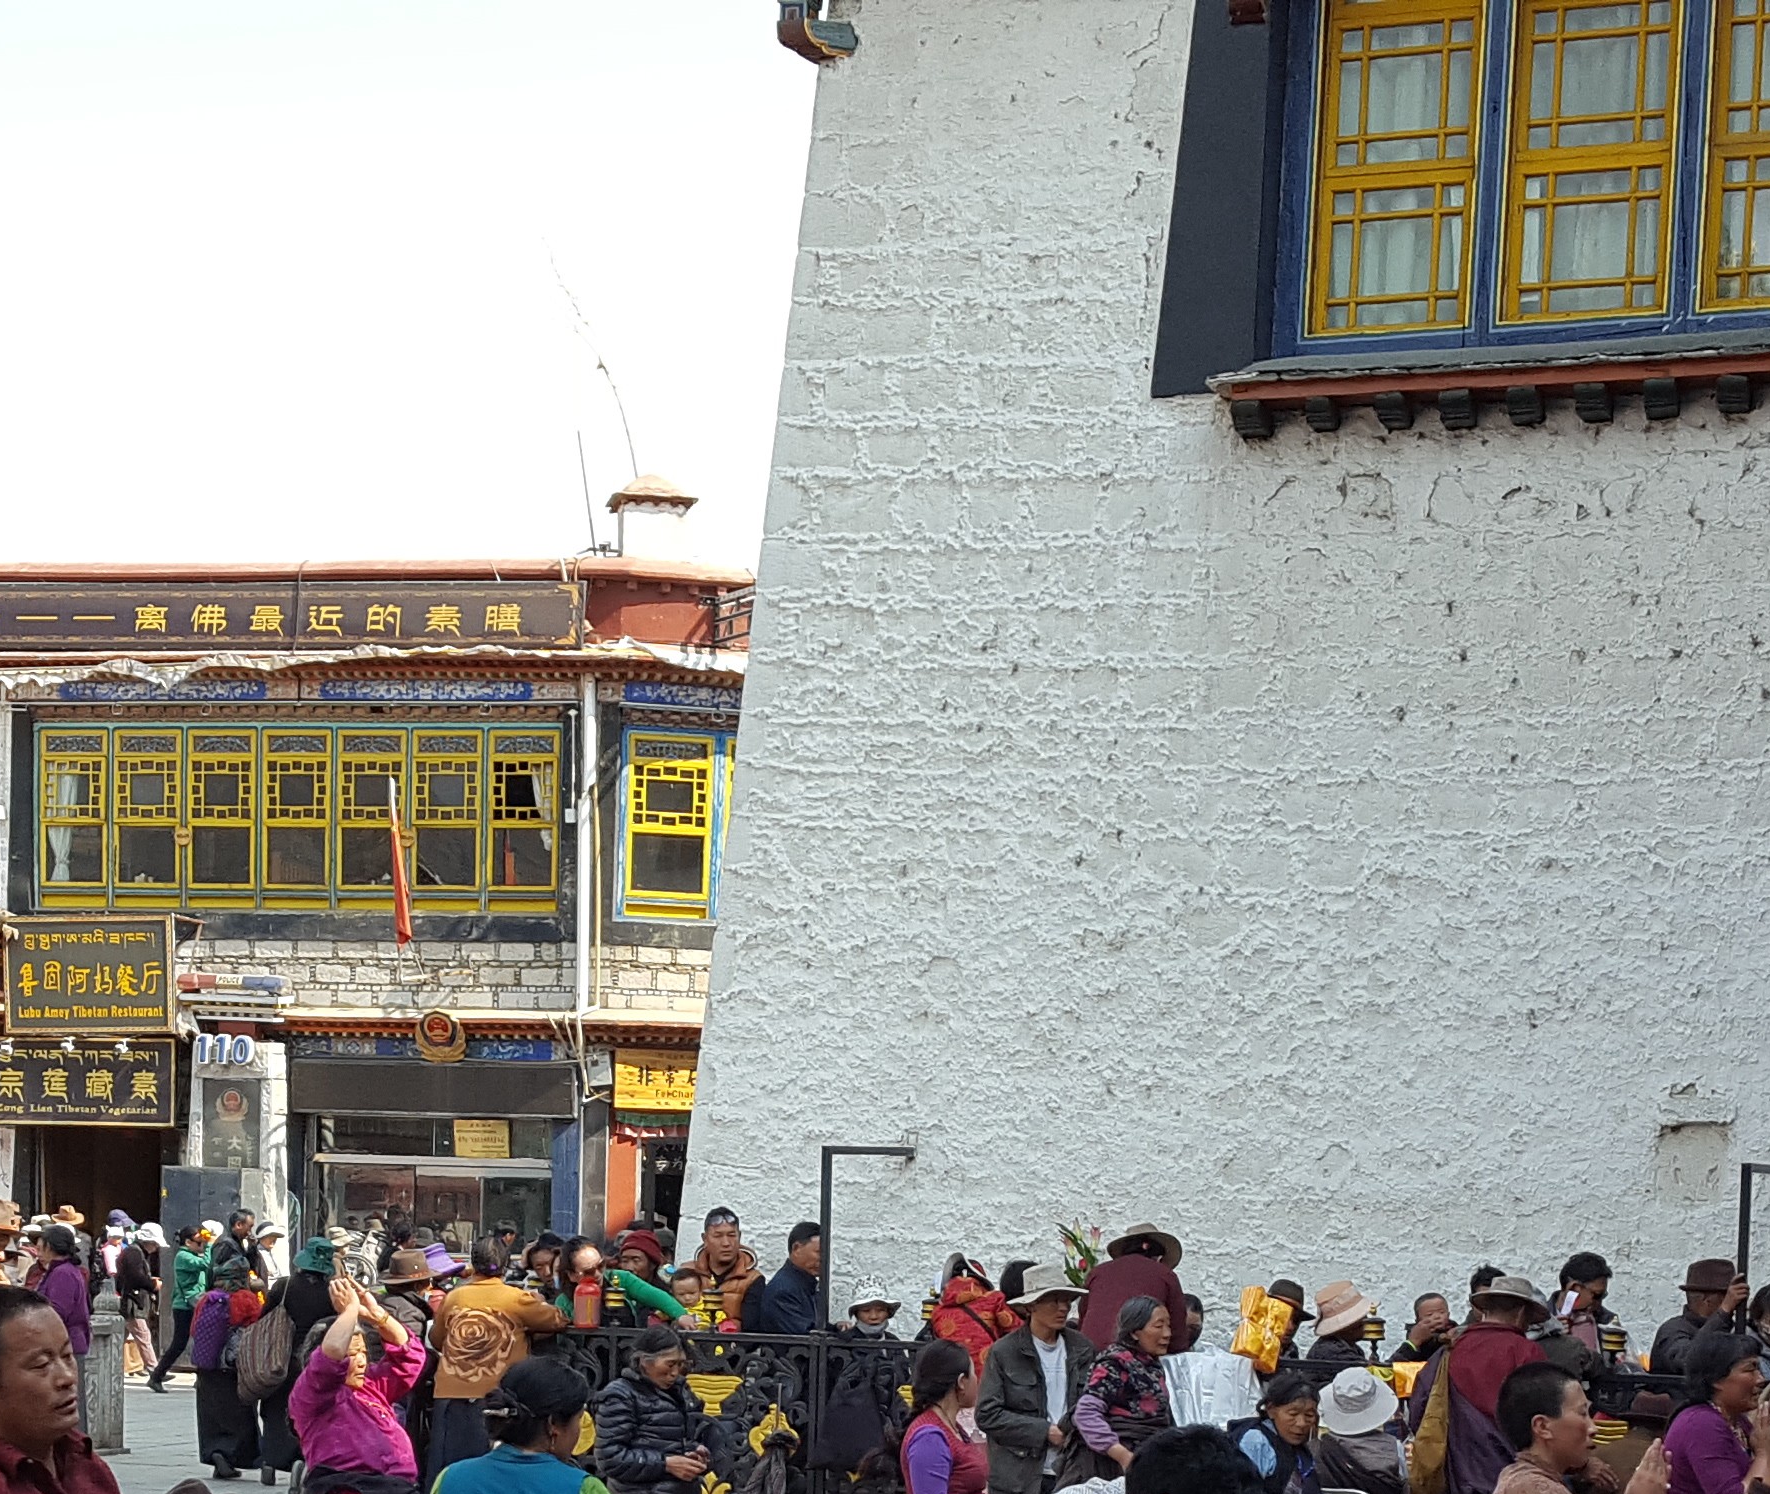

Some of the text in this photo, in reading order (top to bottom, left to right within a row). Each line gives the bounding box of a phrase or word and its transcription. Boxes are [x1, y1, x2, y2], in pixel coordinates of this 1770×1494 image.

[17, 961, 163, 997] 鲁固阿妈餐厅
[217, 976, 241, 985] POLICE
[72, 1005, 108, 1018] Tibetan
[111, 1005, 164, 1018] Restaurant
[196, 1034, 253, 1065] 110
[29, 1103, 53, 1113] Lian
[56, 1104, 97, 1114] Tibetan
[100, 1105, 158, 1116] Vegetarian
